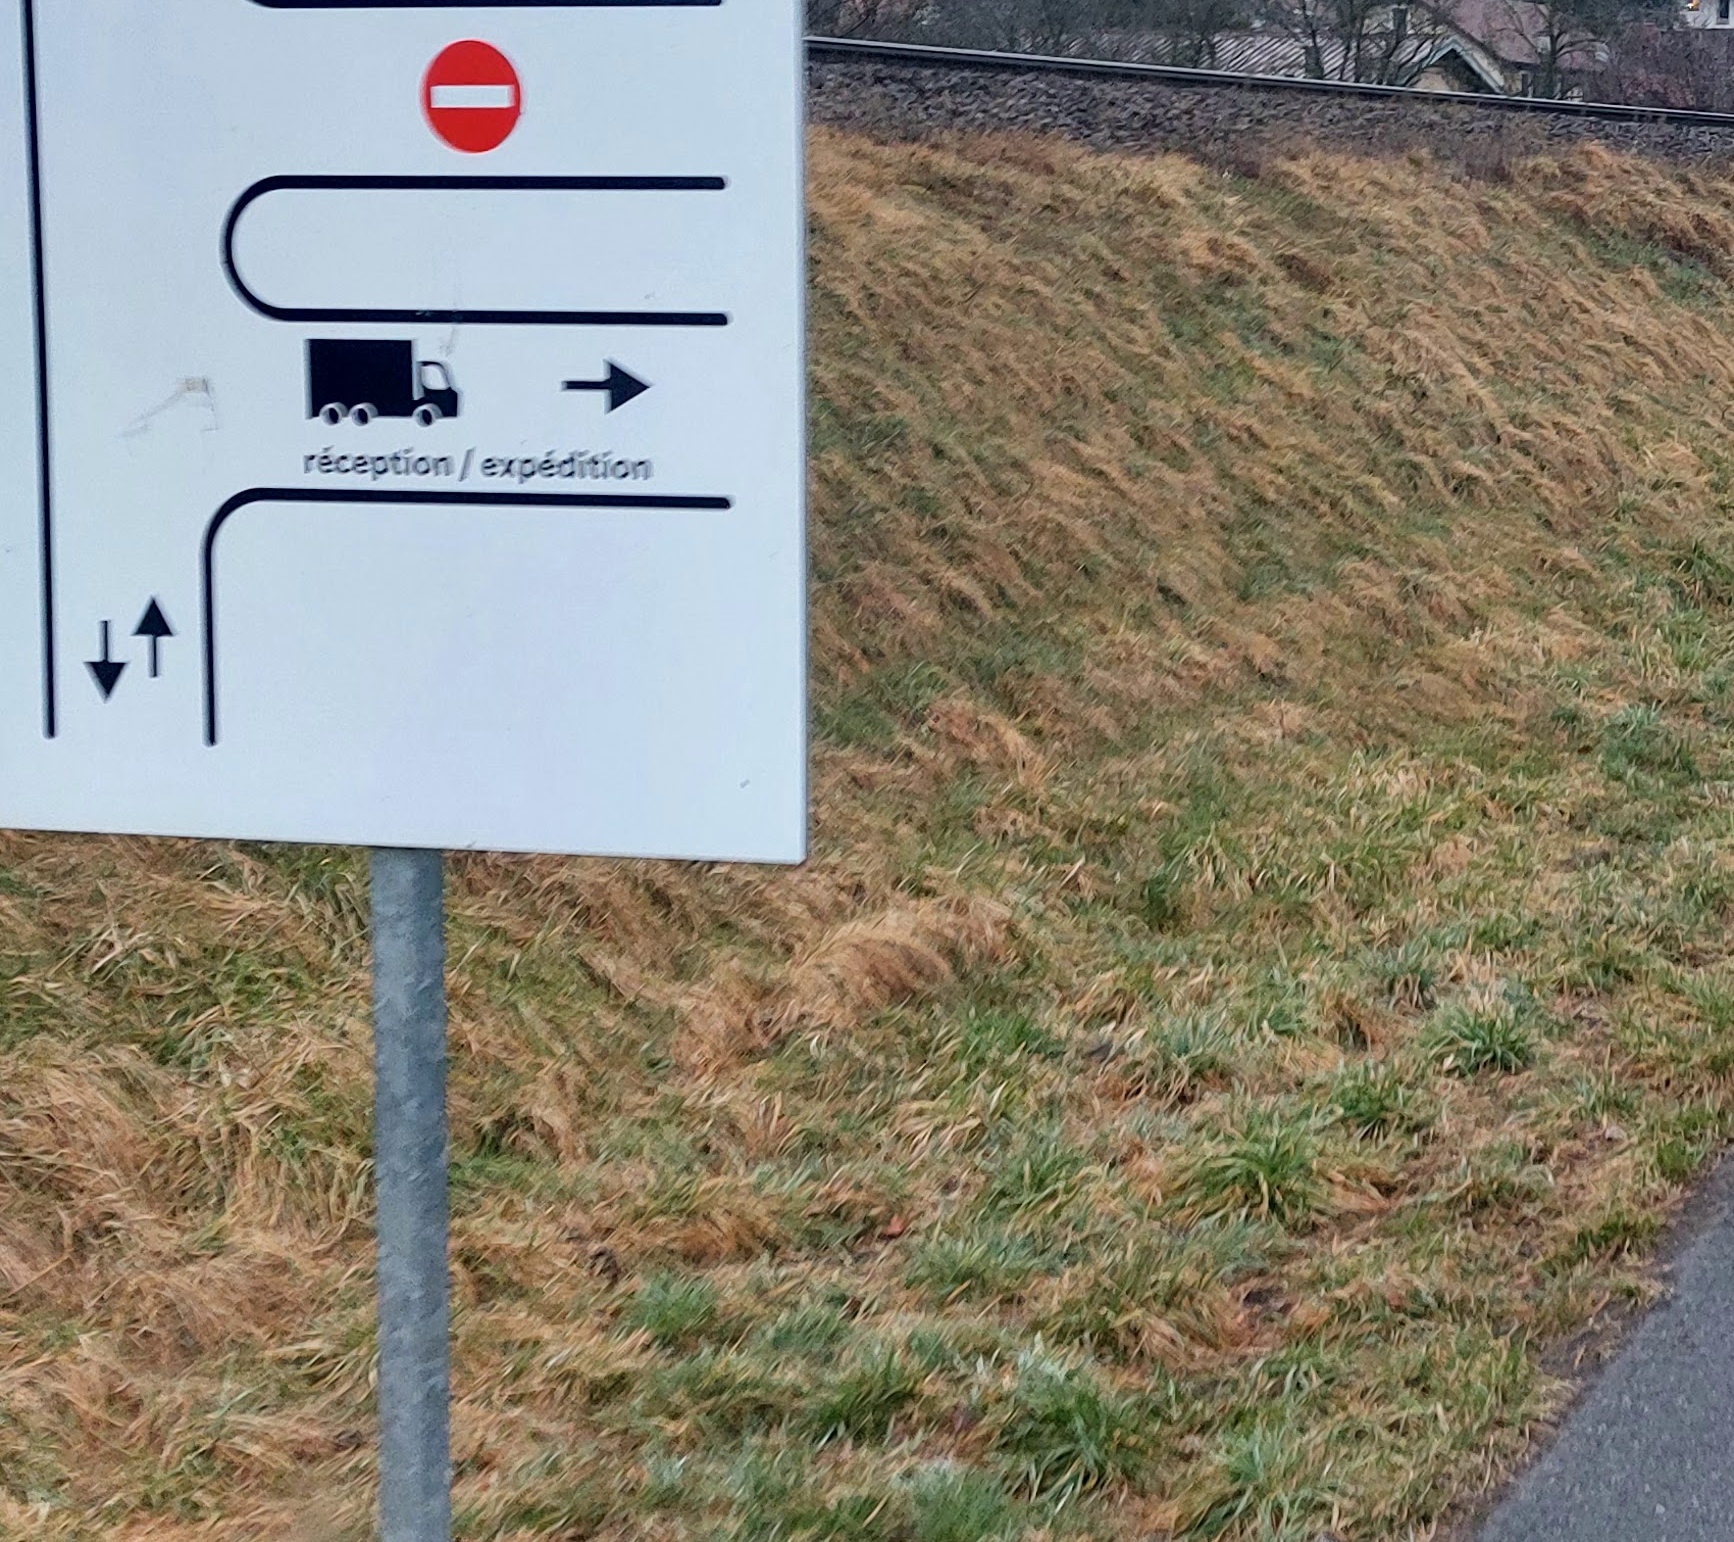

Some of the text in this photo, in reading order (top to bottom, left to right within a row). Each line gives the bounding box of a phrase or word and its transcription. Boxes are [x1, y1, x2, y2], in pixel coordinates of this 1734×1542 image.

[303, 447, 653, 484] réception / expédition
